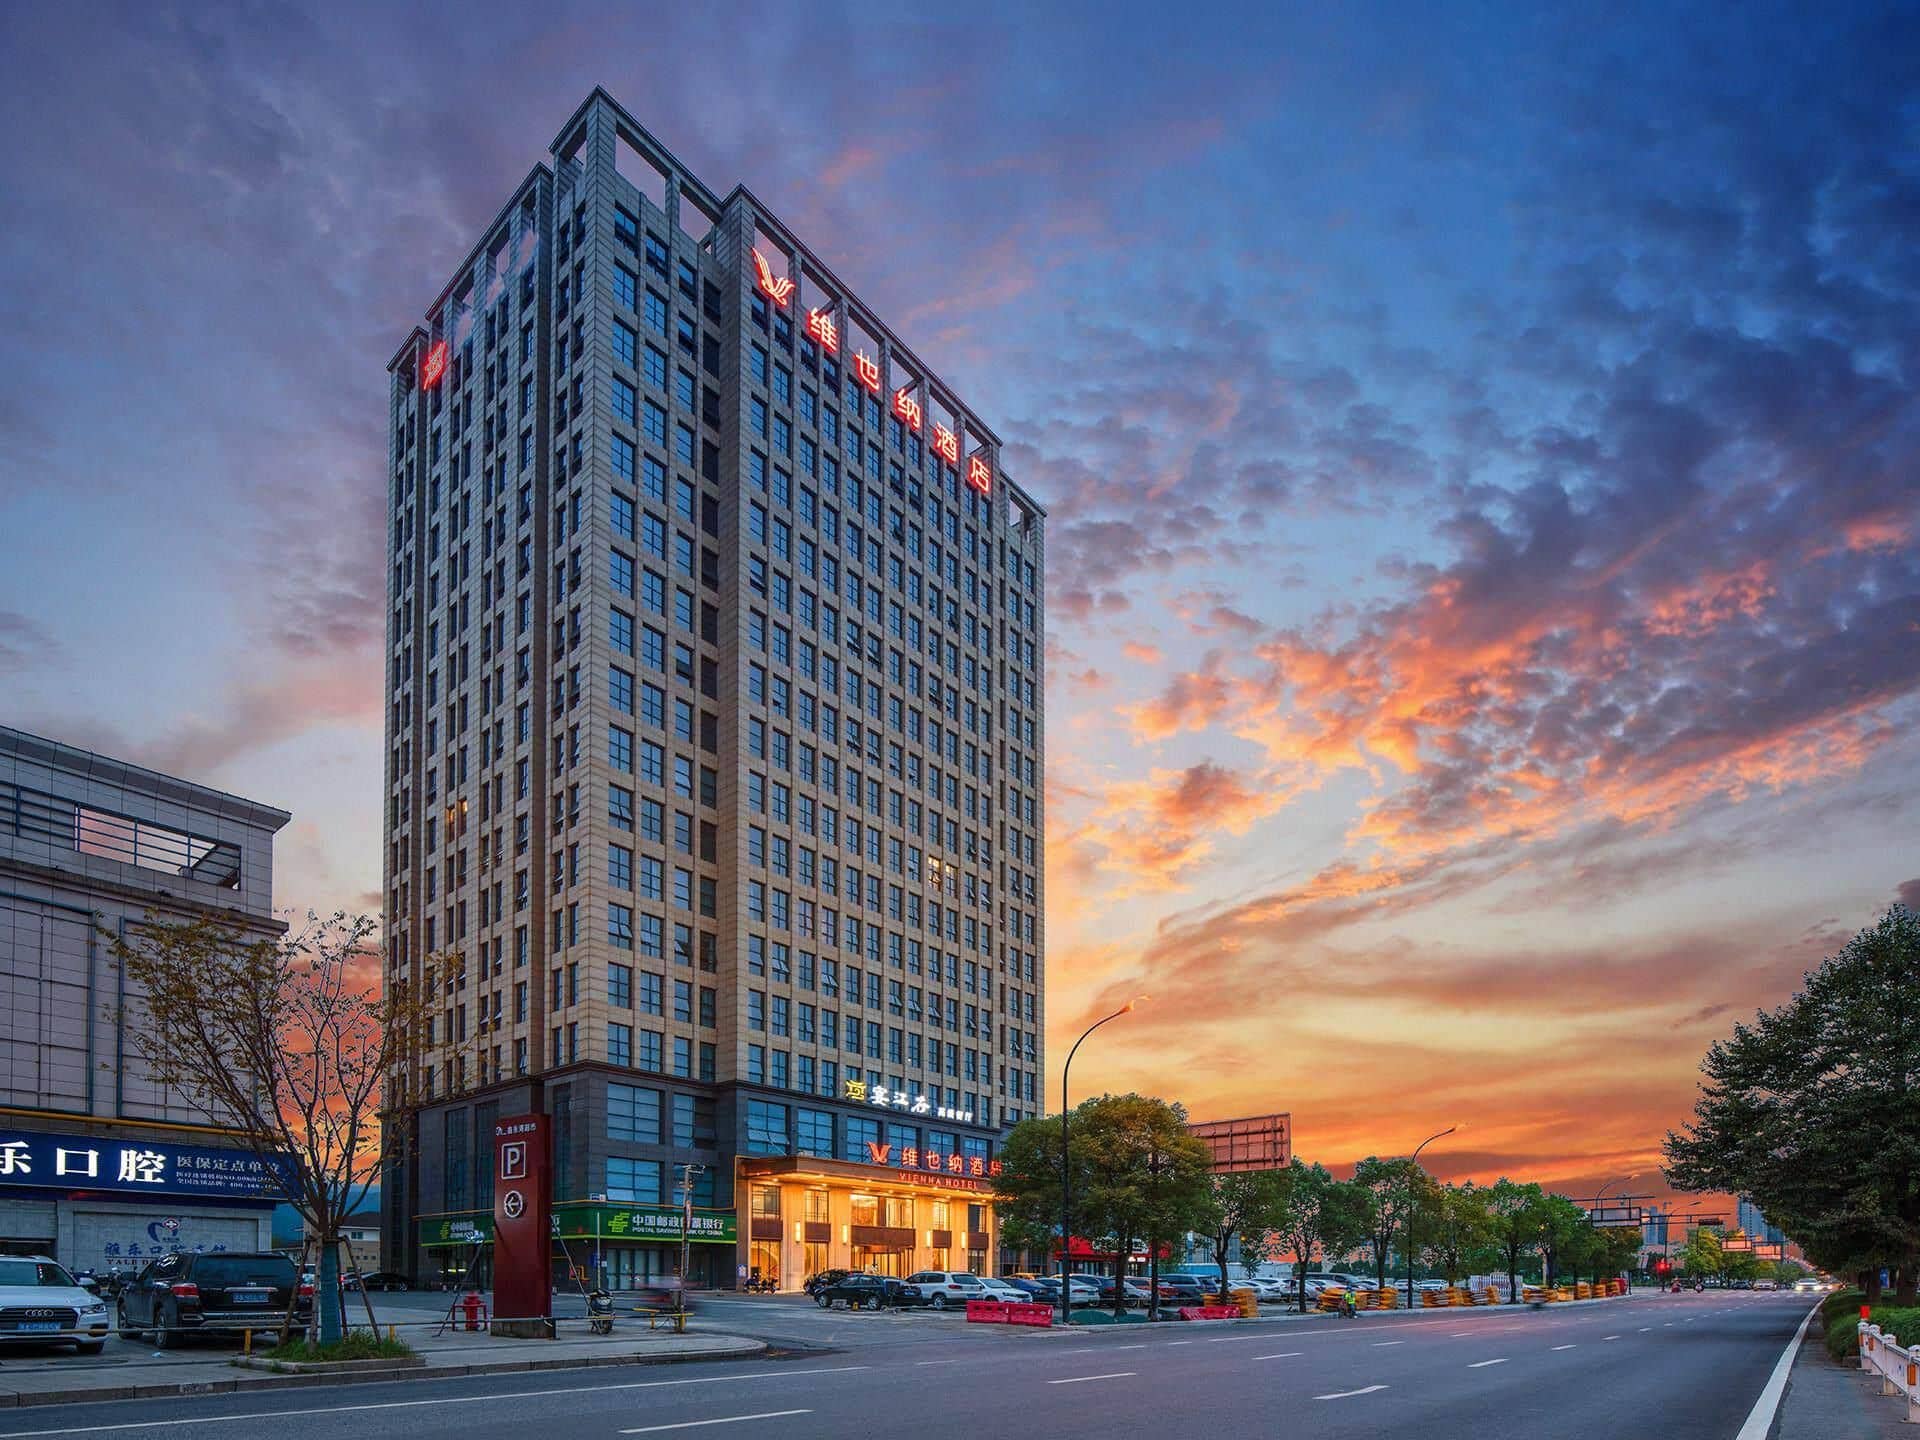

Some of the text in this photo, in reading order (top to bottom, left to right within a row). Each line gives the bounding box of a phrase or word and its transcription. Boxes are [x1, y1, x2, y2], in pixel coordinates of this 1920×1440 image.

[807, 306, 990, 494] 维也纳酒店
[507, 1147, 520, 1174] P
[901, 1146, 1003, 1178] 维也纳酒店
[900, 1173, 977, 1190] VIENNA HOTEL
[632, 1213, 724, 1230] 中国邮政蓄银行
